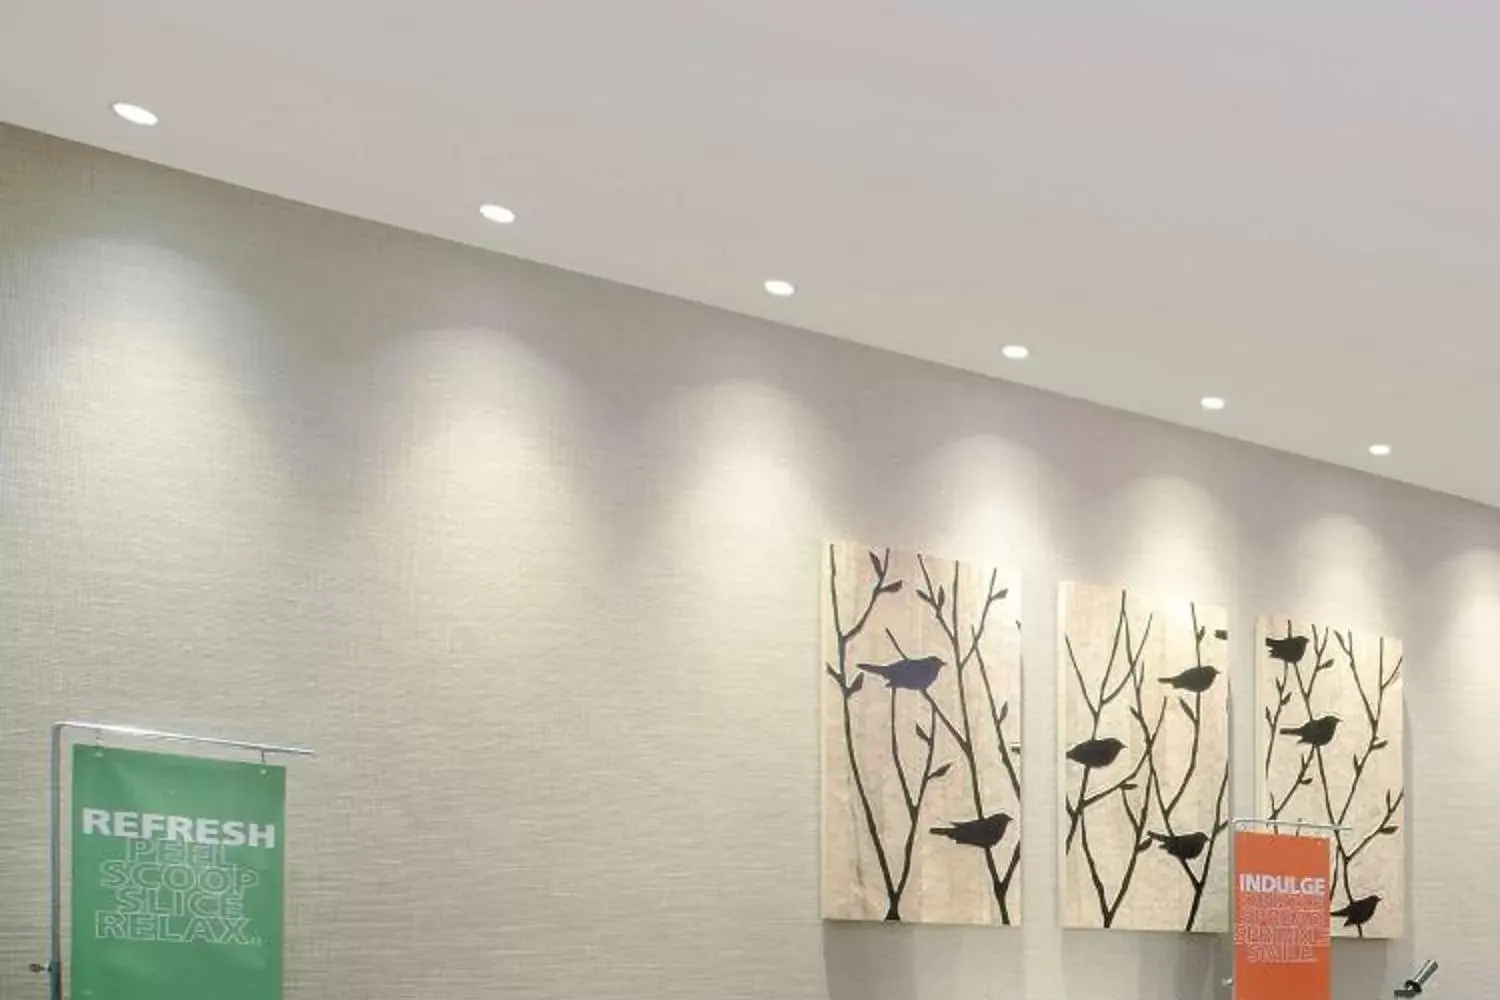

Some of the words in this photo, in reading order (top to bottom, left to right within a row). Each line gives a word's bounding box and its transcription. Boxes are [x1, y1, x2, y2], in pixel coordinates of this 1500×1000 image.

[81, 807, 275, 849] REFRESH
[127, 838, 232, 867] PEEL
[101, 859, 260, 896] SCOOP
[1240, 874, 1325, 896] INDULGE
[114, 886, 245, 919] SLICE
